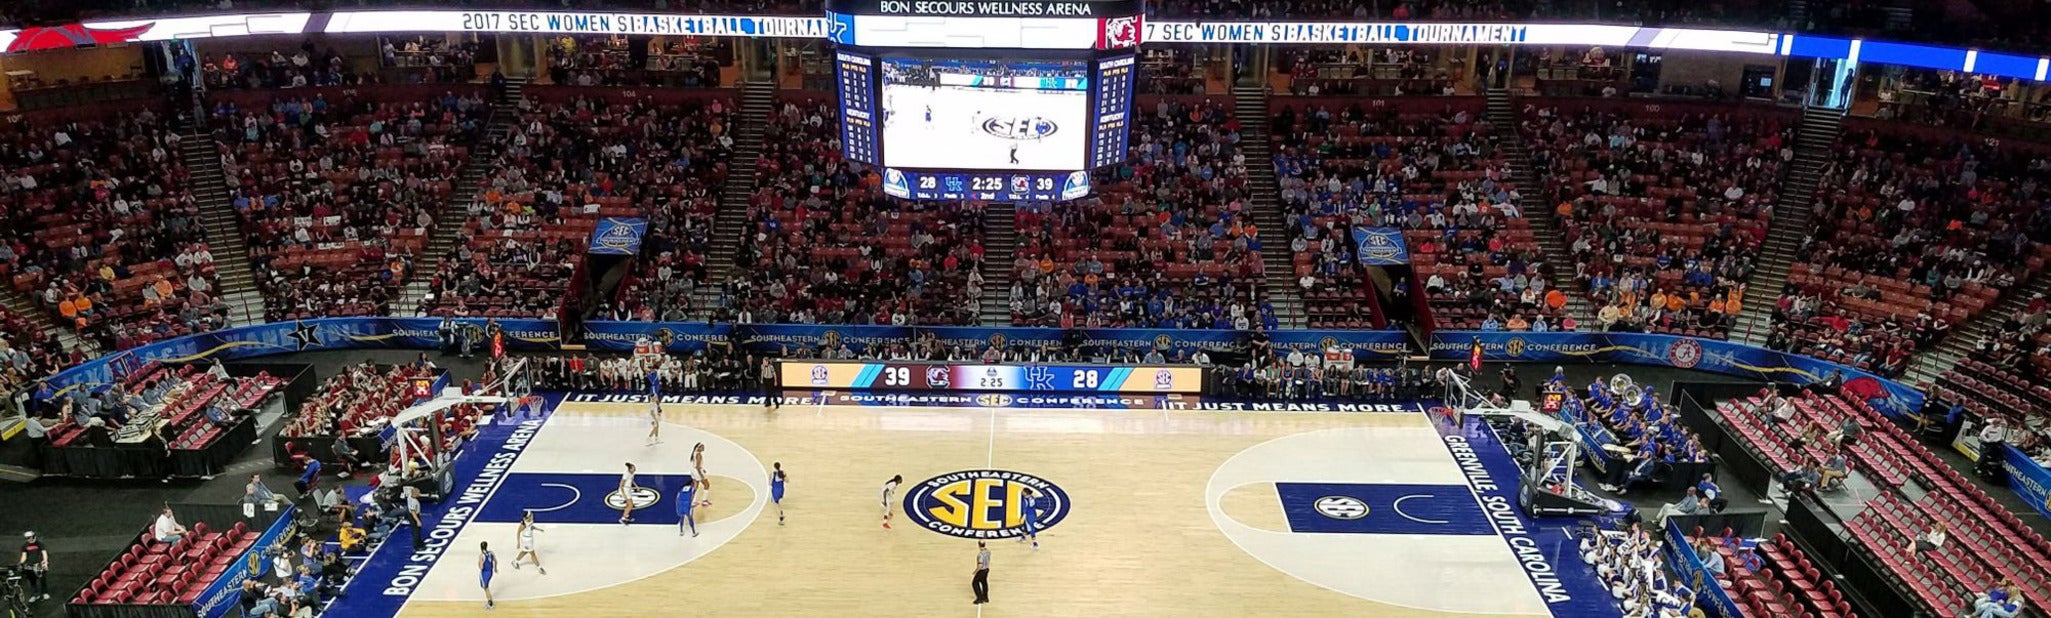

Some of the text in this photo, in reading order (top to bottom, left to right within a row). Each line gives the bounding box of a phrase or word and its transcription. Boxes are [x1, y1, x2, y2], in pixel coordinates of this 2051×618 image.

[880, 1, 1091, 16] BON SECOURS WELLNESS ARENA
[463, 13, 500, 30] 2017
[508, 14, 540, 31] SEC
[634, 16, 744, 34] BASKETBALL
[1163, 24, 1193, 41] SEC
[1287, 25, 1400, 42] BASKETBALL
[1404, 25, 1527, 42] TOURNAMENT
[920, 176, 936, 189] 28
[972, 177, 1003, 190] 2:25
[1037, 178, 1053, 191] 39
[751, 335, 820, 343] SOUTHEASTERN
[1082, 339, 1151, 348] SOUTHEASTERN
[1527, 343, 1597, 352] CONFERENCE
[885, 367, 911, 386] 39
[1073, 369, 1098, 388] 28
[573, 394, 598, 403] IT
[598, 394, 650, 403] JUST
[661, 395, 741, 405] MEANS
[840, 394, 1145, 407] SOUTHEASTERN SEC CONFERENCE
[1167, 401, 1187, 411] IT
[1192, 402, 1246, 411] JUST
[1252, 402, 1331, 412] MEANS
[927, 471, 1050, 490] SOUTHEASTERN
[383, 419, 544, 596] BON SECOURS WELLNESS ARENA
[928, 478, 1044, 529] SEC
[1444, 435, 1572, 603] GREENVILLE, SOUTH CAROLINA
[928, 521, 1045, 538] CONFERENE
[197, 569, 248, 618] SOUTHEASTERN
